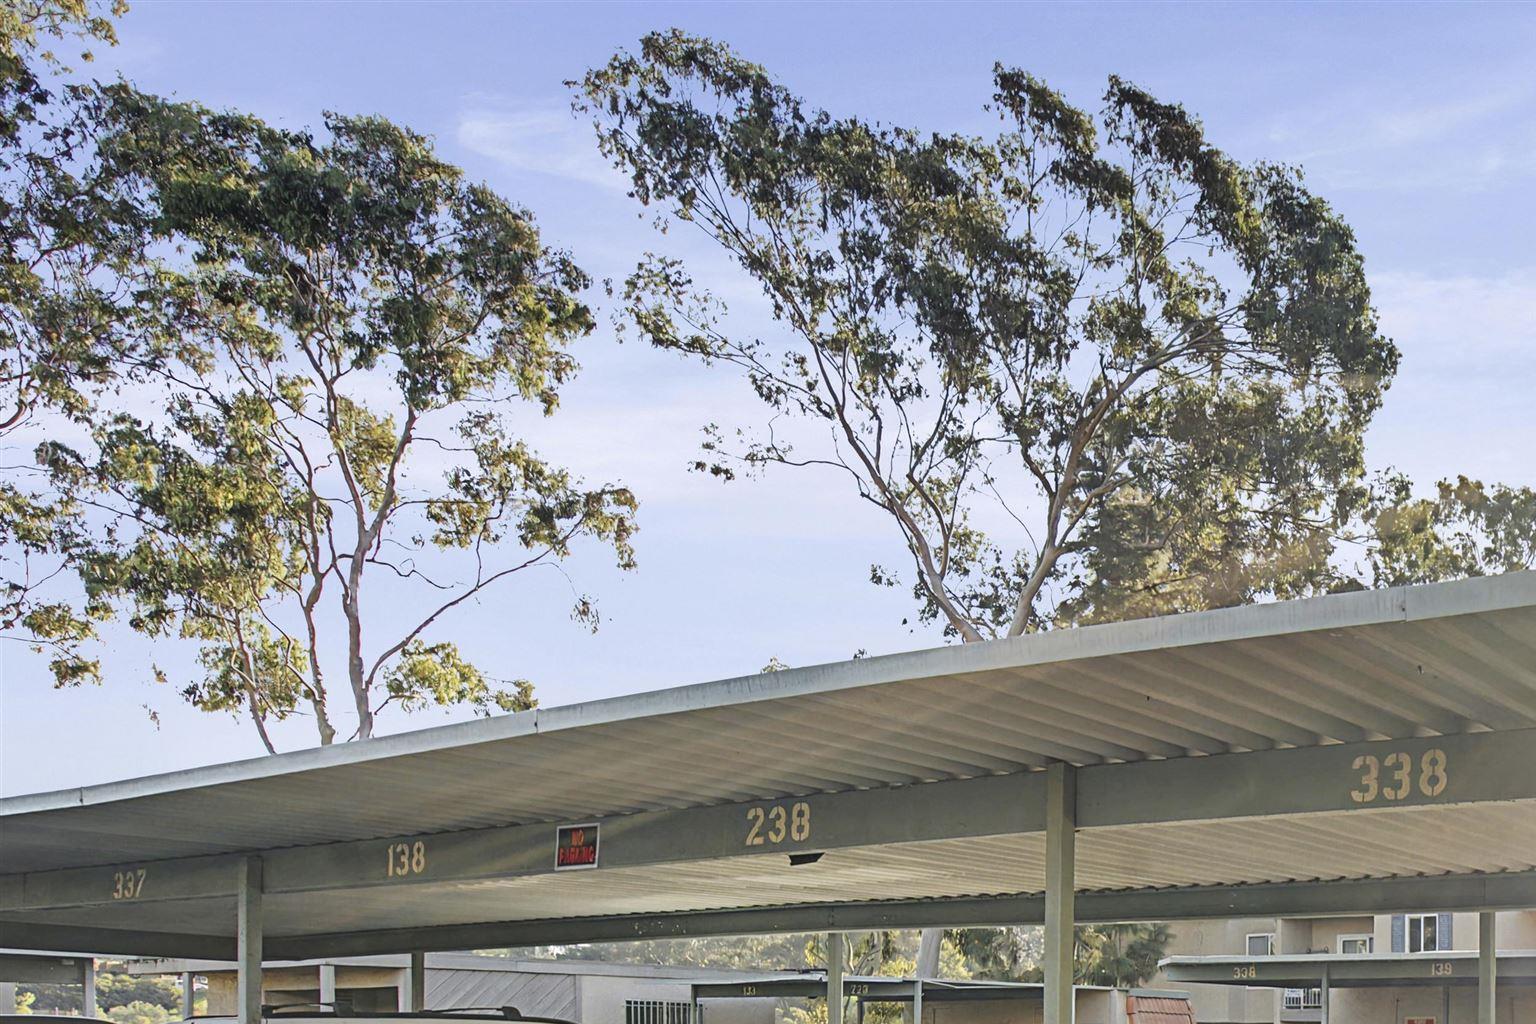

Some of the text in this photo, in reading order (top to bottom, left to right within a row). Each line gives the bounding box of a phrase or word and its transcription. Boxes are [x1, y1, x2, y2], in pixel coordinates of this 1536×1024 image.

[1350, 748, 1448, 803] 338
[745, 802, 811, 846] 238
[386, 840, 426, 877] 138
[112, 868, 147, 900] 337
[1431, 962, 1453, 976] 139
